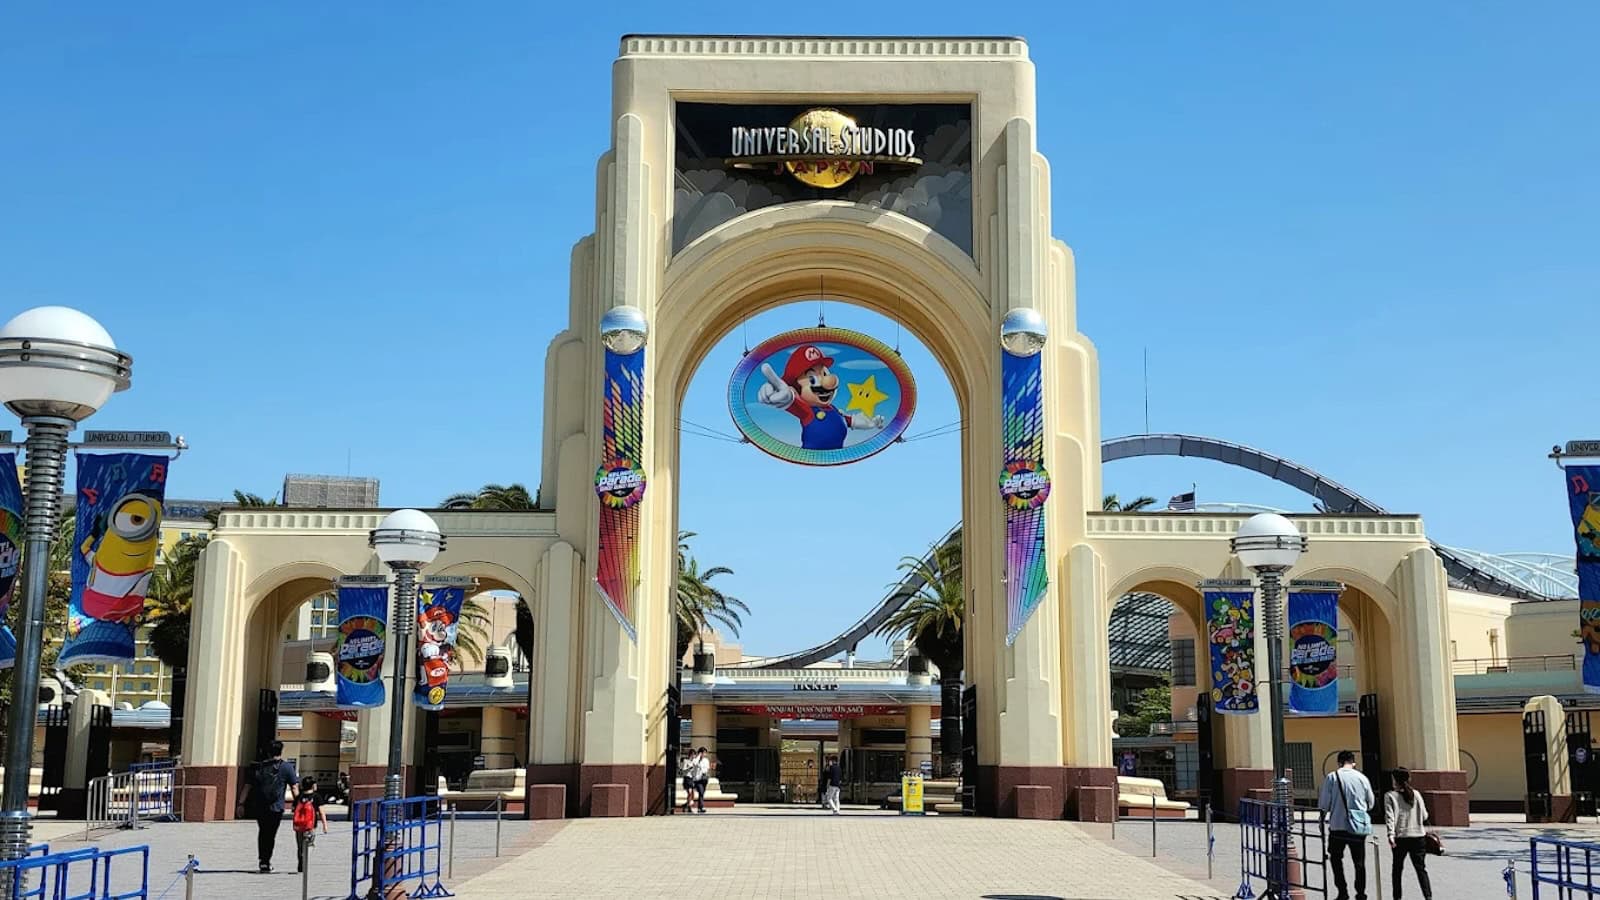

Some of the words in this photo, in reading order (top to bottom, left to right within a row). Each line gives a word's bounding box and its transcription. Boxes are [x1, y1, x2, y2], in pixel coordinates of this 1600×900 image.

[731, 126, 834, 157] UNIVERSAL
[840, 126, 915, 157] STUDIOS
[774, 160, 874, 175] JAPAN
[89, 432, 128, 442] UNIVERSAL
[599, 473, 642, 487] Parade
[1003, 474, 1046, 489] Parade
[340, 639, 384, 655] Parade
[1291, 645, 1336, 660] Parade
[793, 677, 840, 691] TICKETS
[767, 705, 794, 713] ANNUAL
[797, 705, 814, 713] PASS
[815, 705, 833, 713] NOW
[834, 705, 846, 713] ON
